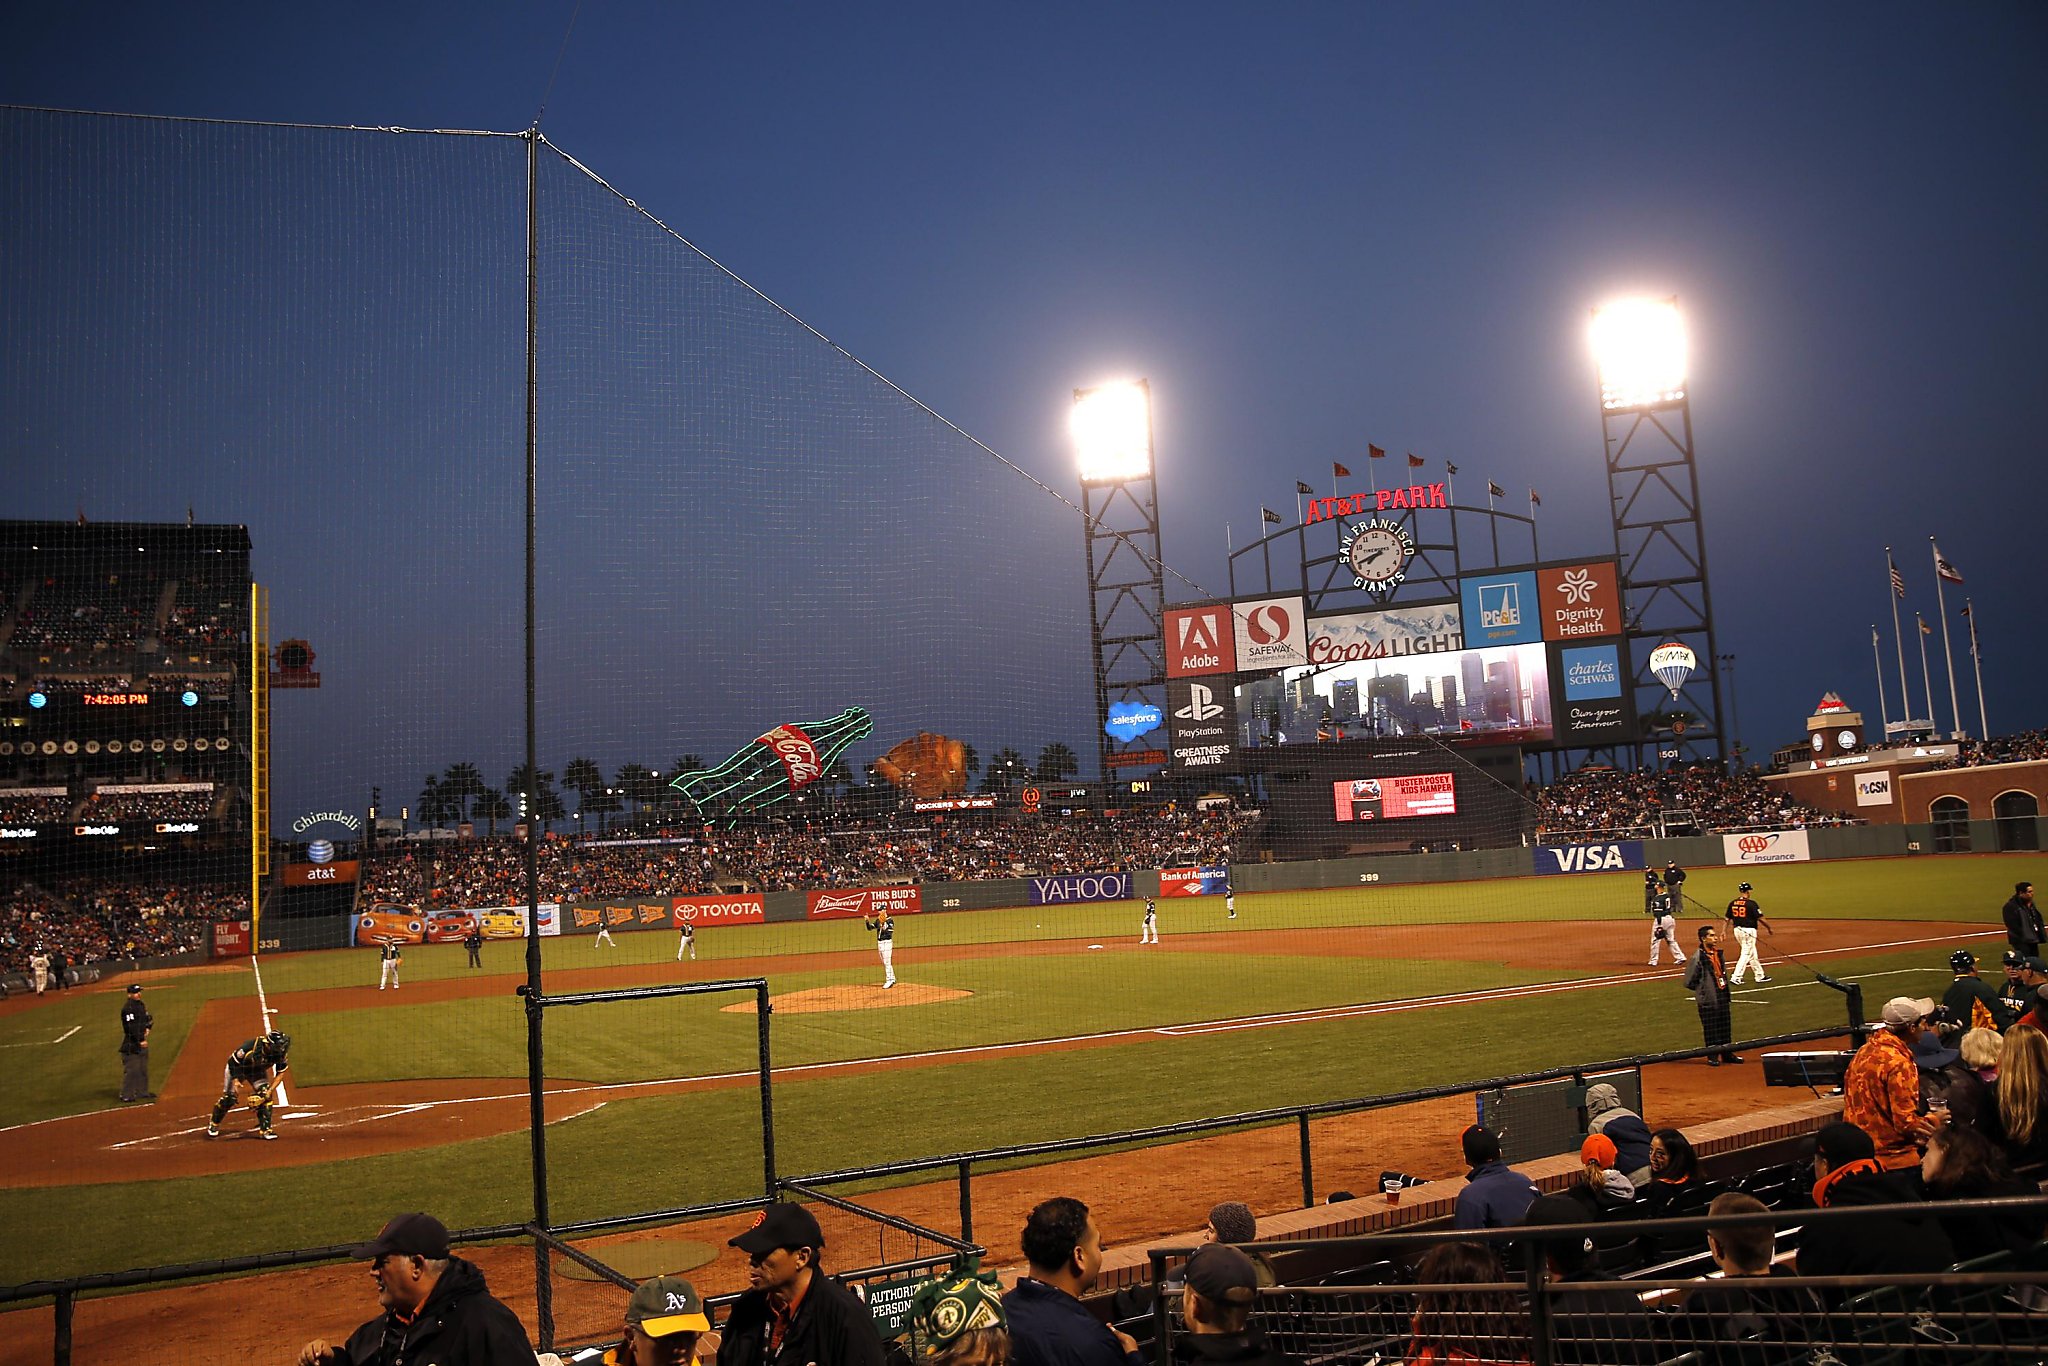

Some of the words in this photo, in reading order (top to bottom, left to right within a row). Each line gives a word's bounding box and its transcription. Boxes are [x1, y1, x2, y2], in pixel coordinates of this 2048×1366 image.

[1306, 493, 1366, 525] AT&T
[1375, 482, 1446, 511] PARK
[1339, 536, 1354, 564] SAN
[1351, 518, 1415, 556] FRANCISCO
[1353, 571, 1406, 592] GIANTS
[1483, 608, 1519, 627] PG&E
[1555, 606, 1604, 623] Dignity
[1559, 621, 1604, 636] Health
[1249, 644, 1292, 657] SAFEWAY
[1308, 636, 1389, 665] Coors
[1391, 632, 1463, 657] LIGHT
[1182, 654, 1220, 669] Adobe
[1655, 650, 1690, 663] RE/MAX
[1569, 660, 1613, 676] charles
[1569, 673, 1615, 686] SCHWAB
[84, 694, 127, 705] 7:42:05
[129, 694, 148, 704] PM
[1112, 713, 1157, 727] salesforce
[1594, 708, 1620, 722] your
[1571, 720, 1622, 730] tomorrow
[1178, 727, 1223, 739] PlayStation
[1174, 745, 1230, 758] GREATNESS
[776, 739, 819, 783] Cola
[1184, 756, 1222, 767] AWAITS
[1394, 778, 1424, 788] BUSTER
[1424, 776, 1450, 785] POSEY
[1869, 781, 1888, 794] CSN
[1400, 786, 1419, 795] KIDS
[1420, 783, 1452, 793] HAMPER
[915, 801, 954, 810] DOCKERS
[971, 799, 993, 807] DECK
[292, 810, 361, 833] Ghirardelli
[1741, 836, 1764, 852] AAA
[1548, 845, 1624, 871] VISA
[1754, 853, 1795, 862] Insurance
[307, 867, 336, 880] at&t
[1161, 872, 1182, 881] Bank
[1182, 871, 1191, 879] of
[1191, 870, 1226, 879] America
[1360, 873, 1379, 881] 399
[870, 891, 890, 900] THIS
[891, 889, 916, 899] BUD'S
[1034, 874, 1127, 903] YAHOO!
[700, 902, 762, 917] TOYOTA
[819, 899, 861, 908] Budweiser
[871, 901, 888, 911] FOR
[889, 900, 908, 910] YOU.
[942, 899, 960, 907] 382
[1731, 906, 1746, 917] 58
[216, 924, 229, 934] FLY
[259, 940, 280, 949] 339
[870, 1284, 919, 1305] AUTHORIZ
[664, 1292, 687, 1312] A's
[872, 1300, 914, 1319] PERSON
